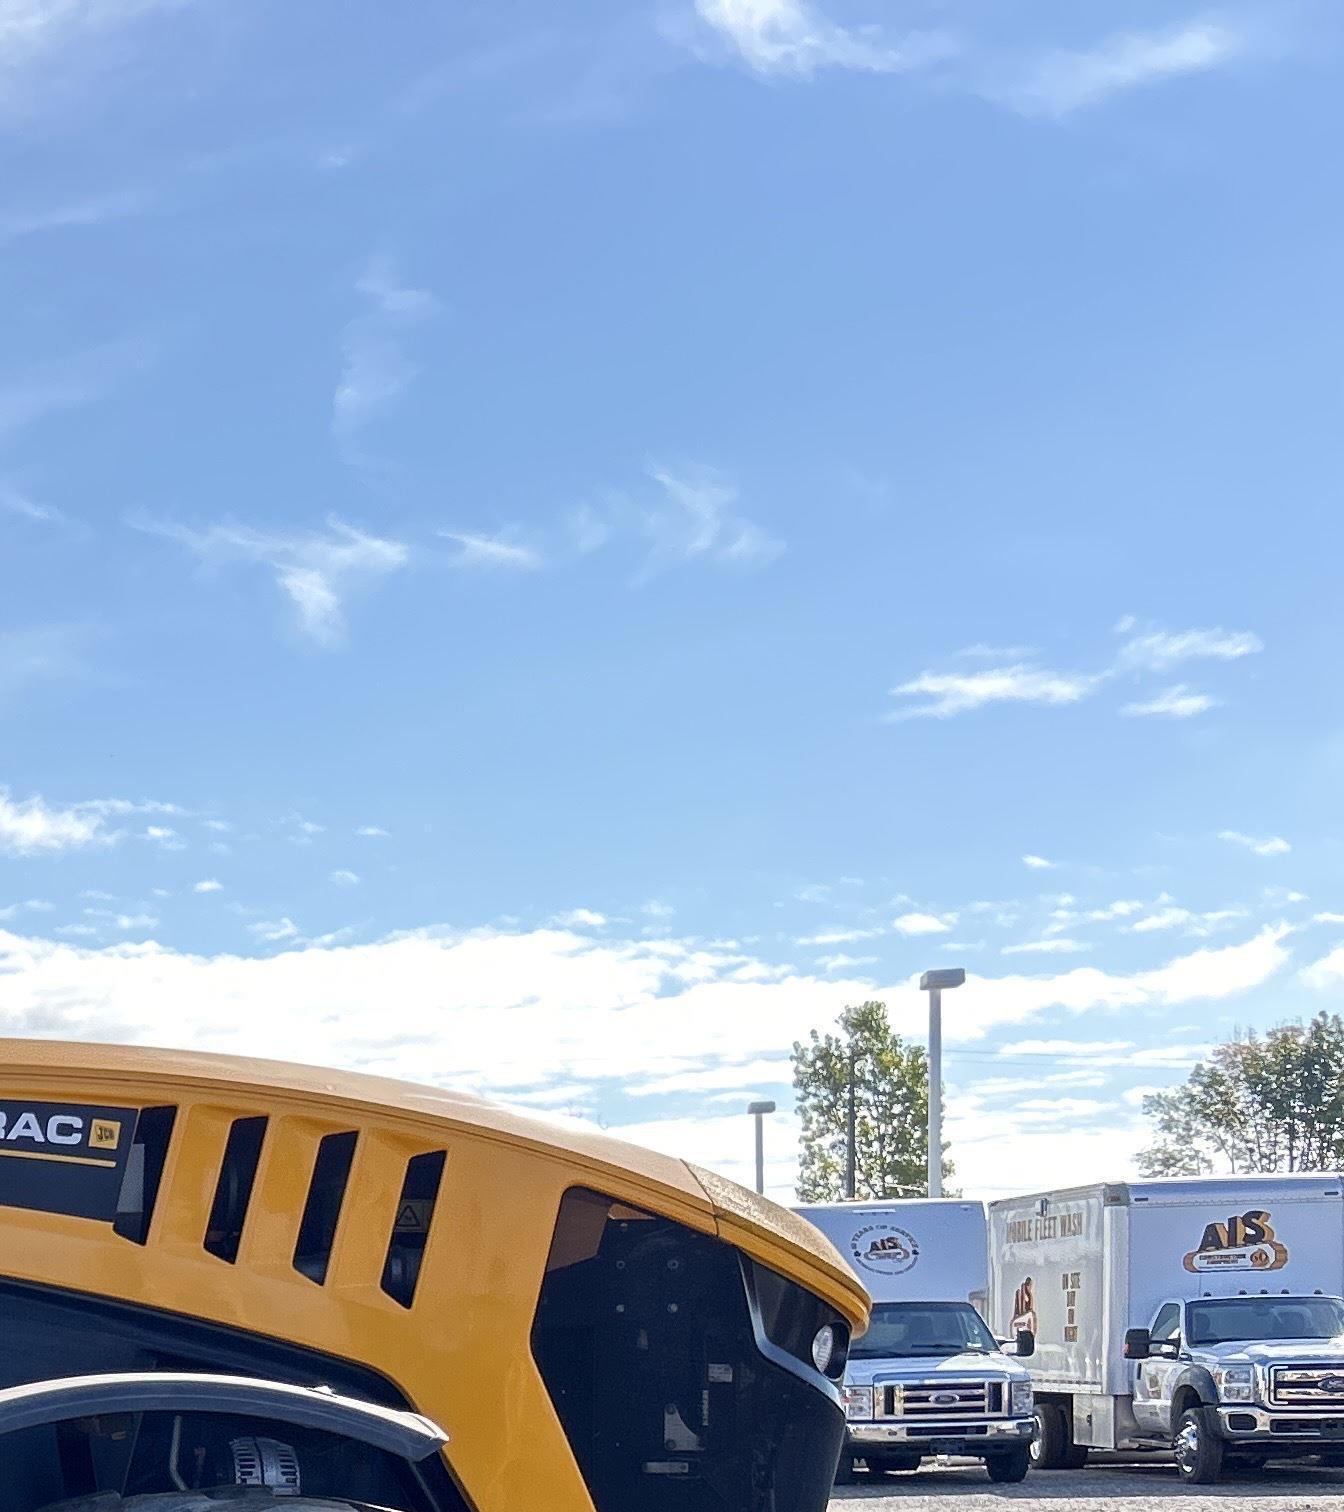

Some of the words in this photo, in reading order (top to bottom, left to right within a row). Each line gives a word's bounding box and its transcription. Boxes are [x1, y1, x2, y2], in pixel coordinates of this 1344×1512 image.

[1035, 1216, 1057, 1240] FLEET
[1060, 1211, 1083, 1236] WASH
[1197, 1210, 1275, 1252] AIS
